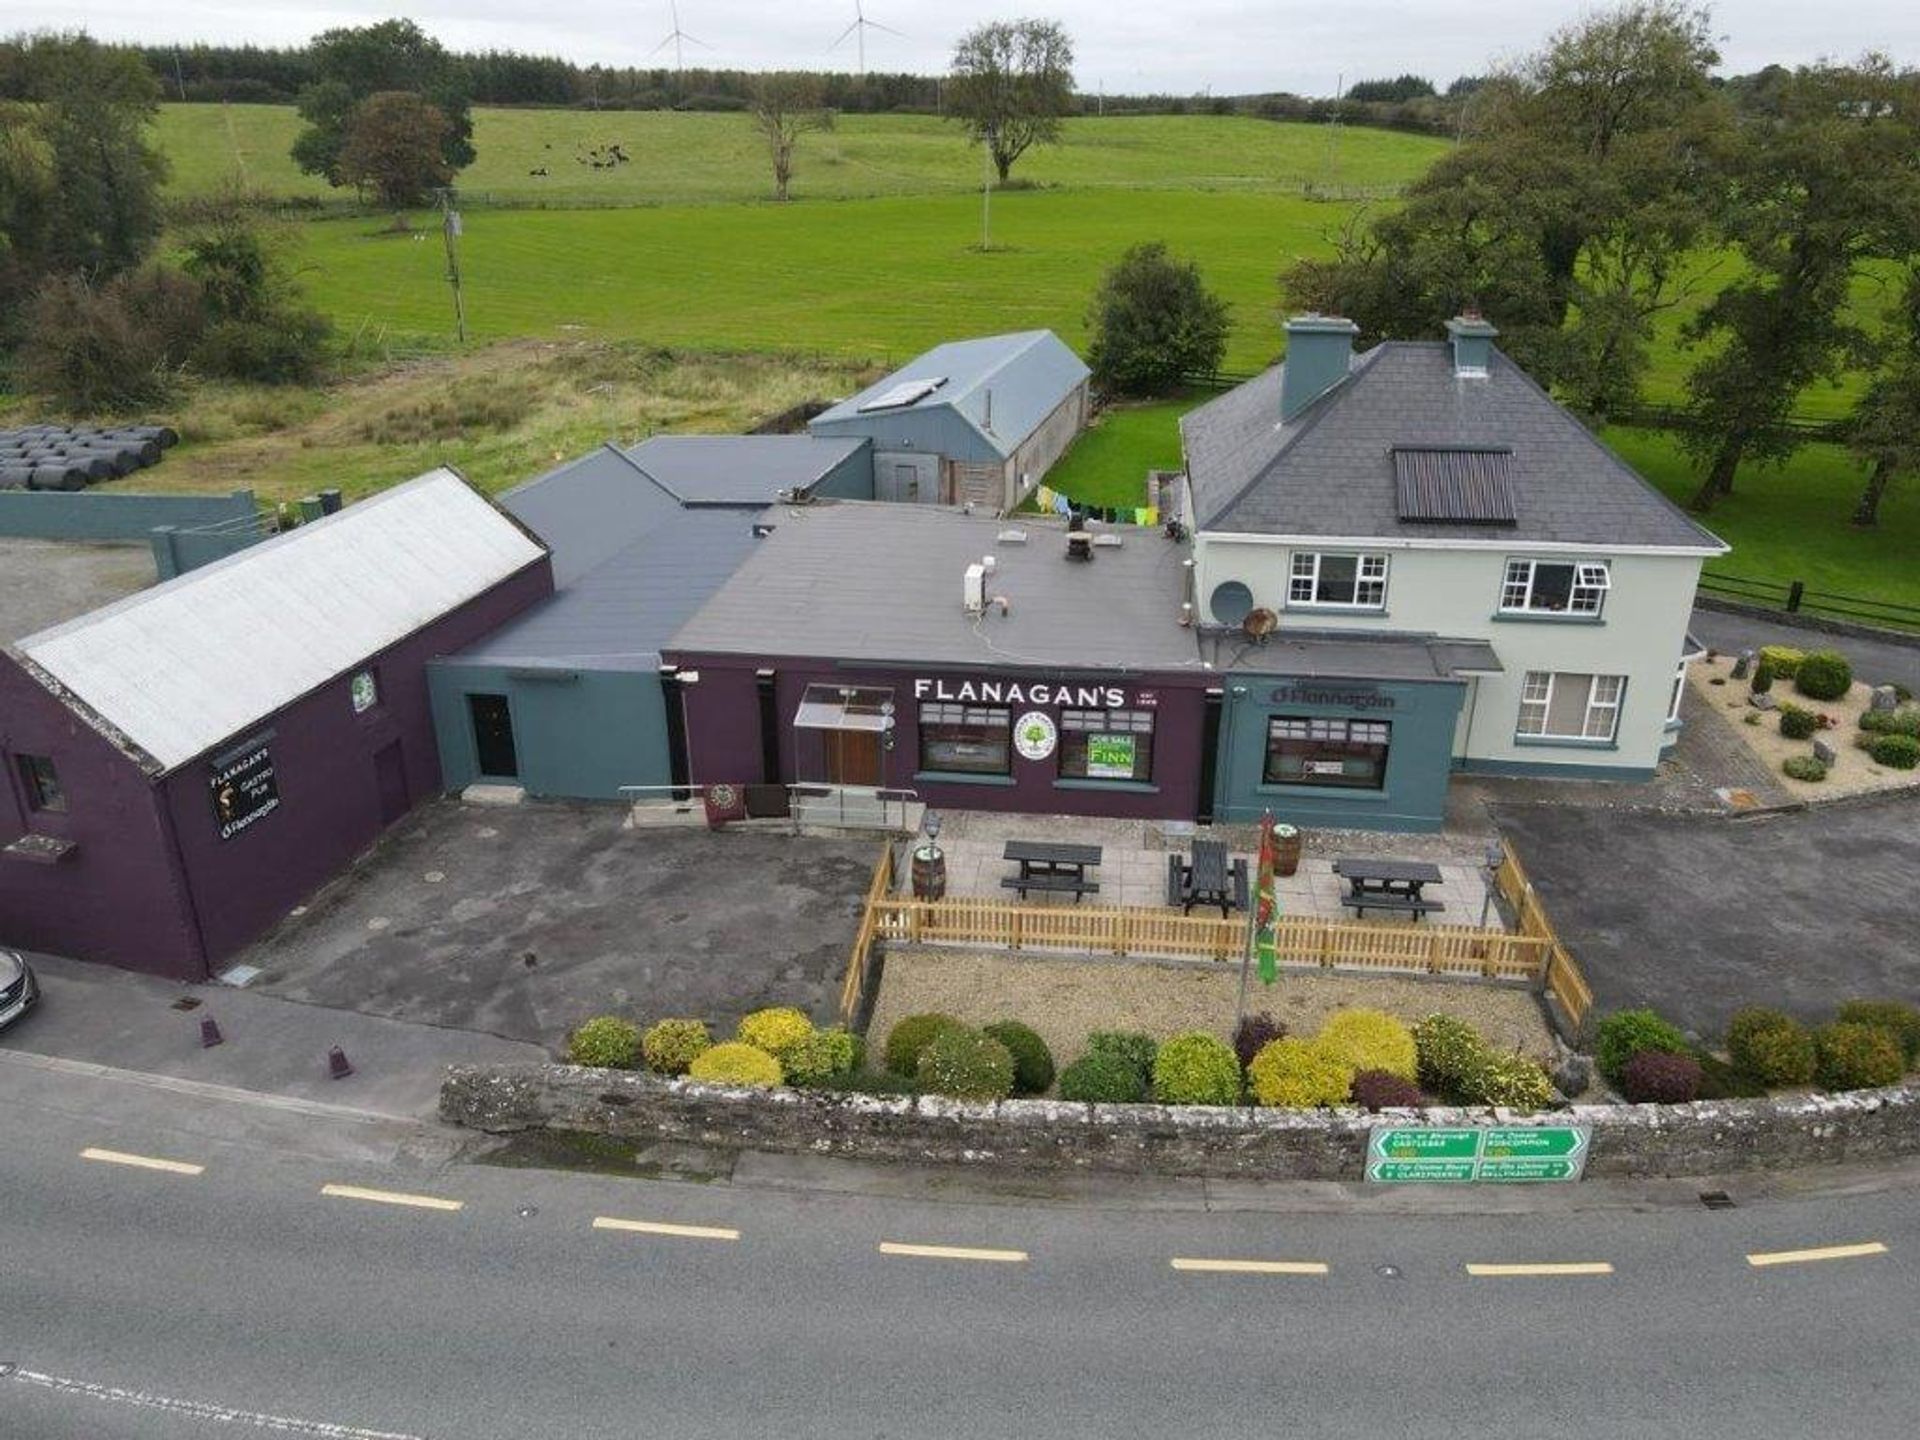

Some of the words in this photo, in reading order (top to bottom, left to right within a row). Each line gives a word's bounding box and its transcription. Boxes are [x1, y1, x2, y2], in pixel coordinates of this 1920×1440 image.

[914, 678, 1125, 707] FLANAGAN'S
[1091, 735, 1109, 744] FOR
[1110, 736, 1132, 745] SALE
[1091, 749, 1132, 763] FINN
[240, 767, 273, 792] GASTRO
